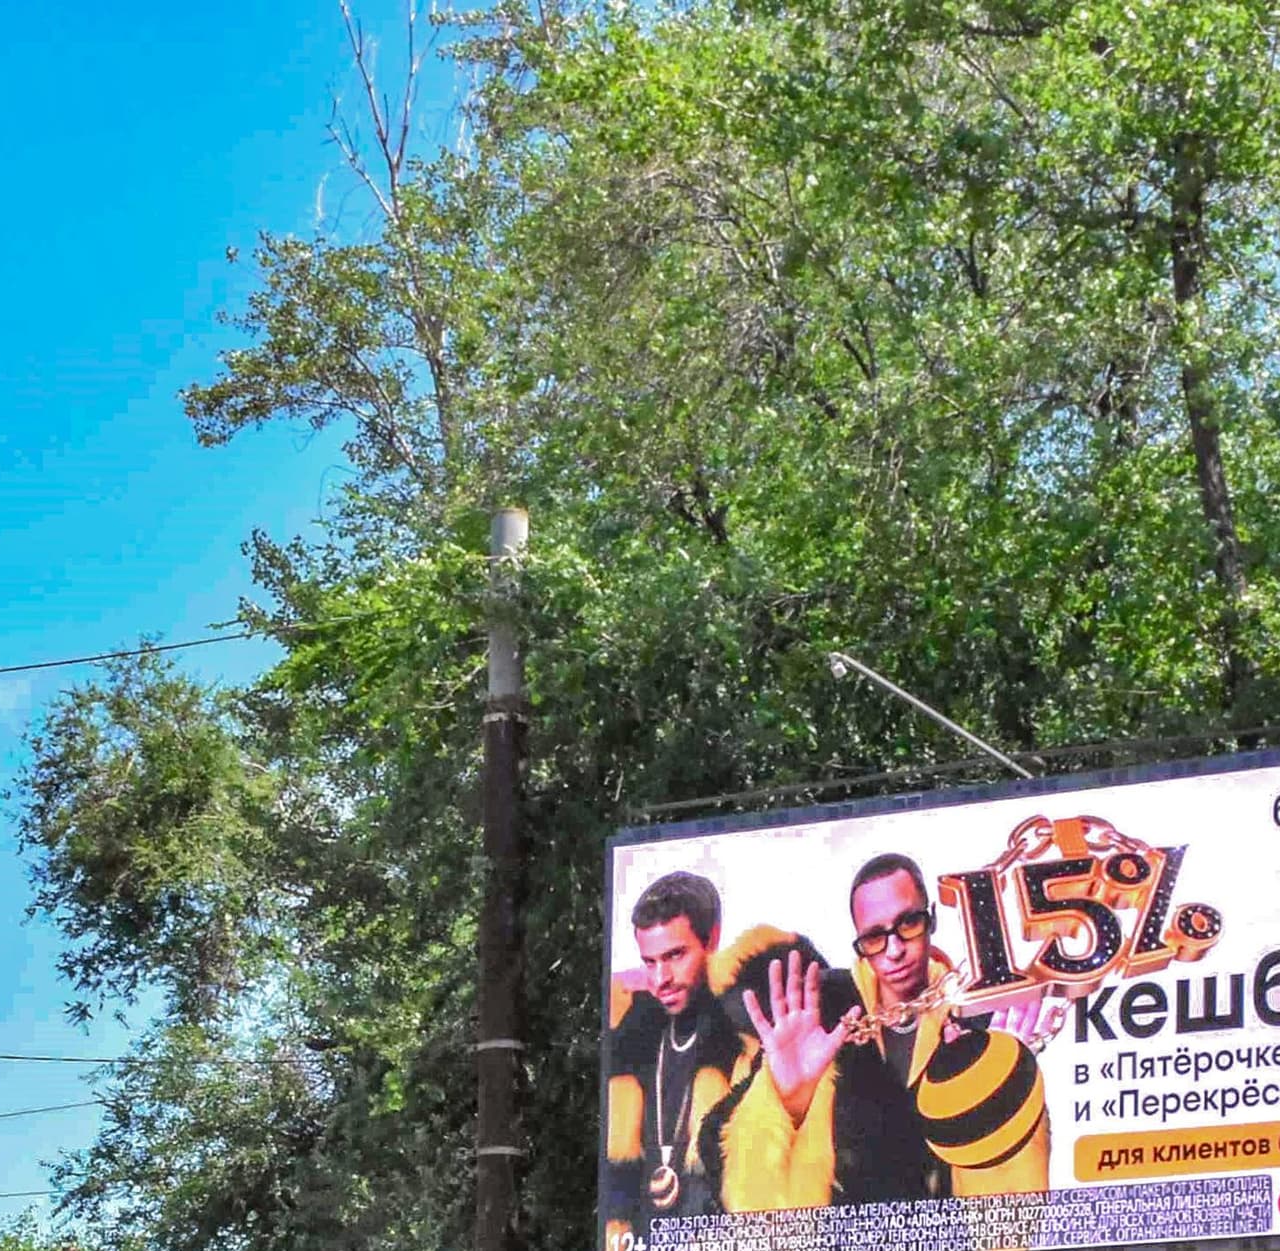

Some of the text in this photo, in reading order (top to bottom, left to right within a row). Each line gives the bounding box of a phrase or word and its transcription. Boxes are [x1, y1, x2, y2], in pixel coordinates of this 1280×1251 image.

[938, 843, 1223, 1000] 15%
[1075, 1064, 1089, 1085] в
[1075, 1099, 1091, 1122] и
[1097, 1148, 1144, 1171] для
[1152, 1137, 1270, 1163] клиентов
[650, 1229, 695, 1244] ПОКУПОК
[1095, 1196, 1170, 1214] ГЕНЕРАЛЬНАЯ
[1172, 1192, 1231, 1209] ЛИЦЕНЗИЯ
[1233, 1189, 1271, 1205] БАНКА
[745, 1207, 811, 1224] УЧАСТНИКАМ
[812, 1204, 855, 1220] СЕРВИСА
[914, 1198, 940, 1213] РЯДУ
[942, 1194, 1001, 1211] АБОНЕНТОВ
[1004, 1191, 1043, 1206] ТАРИФА
[1227, 1175, 1270, 1191] ОПЛАТЕ
[888, 1226, 937, 1242] ТЕЛЕФОНА
